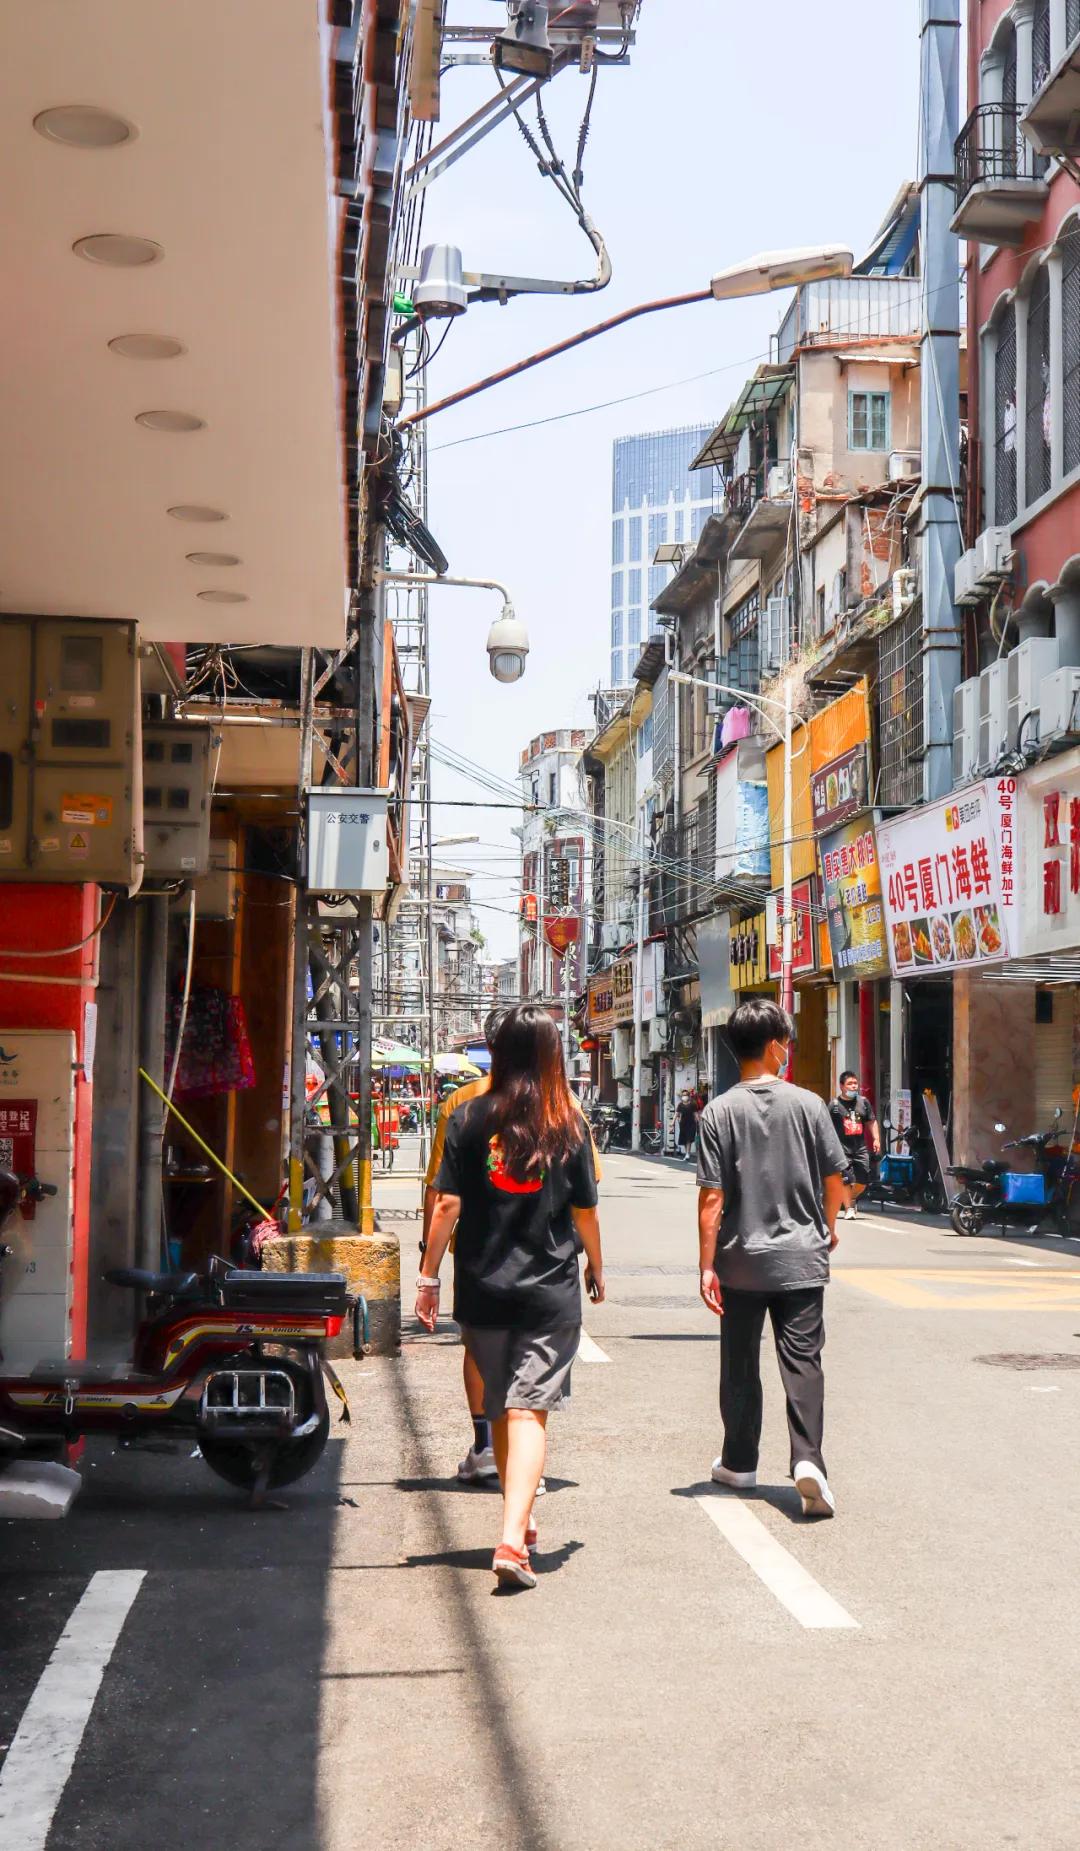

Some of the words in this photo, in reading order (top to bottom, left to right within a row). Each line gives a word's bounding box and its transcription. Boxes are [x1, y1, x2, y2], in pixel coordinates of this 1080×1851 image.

[327, 813, 370, 824] 公安交警
[997, 779, 1016, 906] 40号厦门海鲜加工
[888, 836, 992, 913] 40号厦门海鲜
